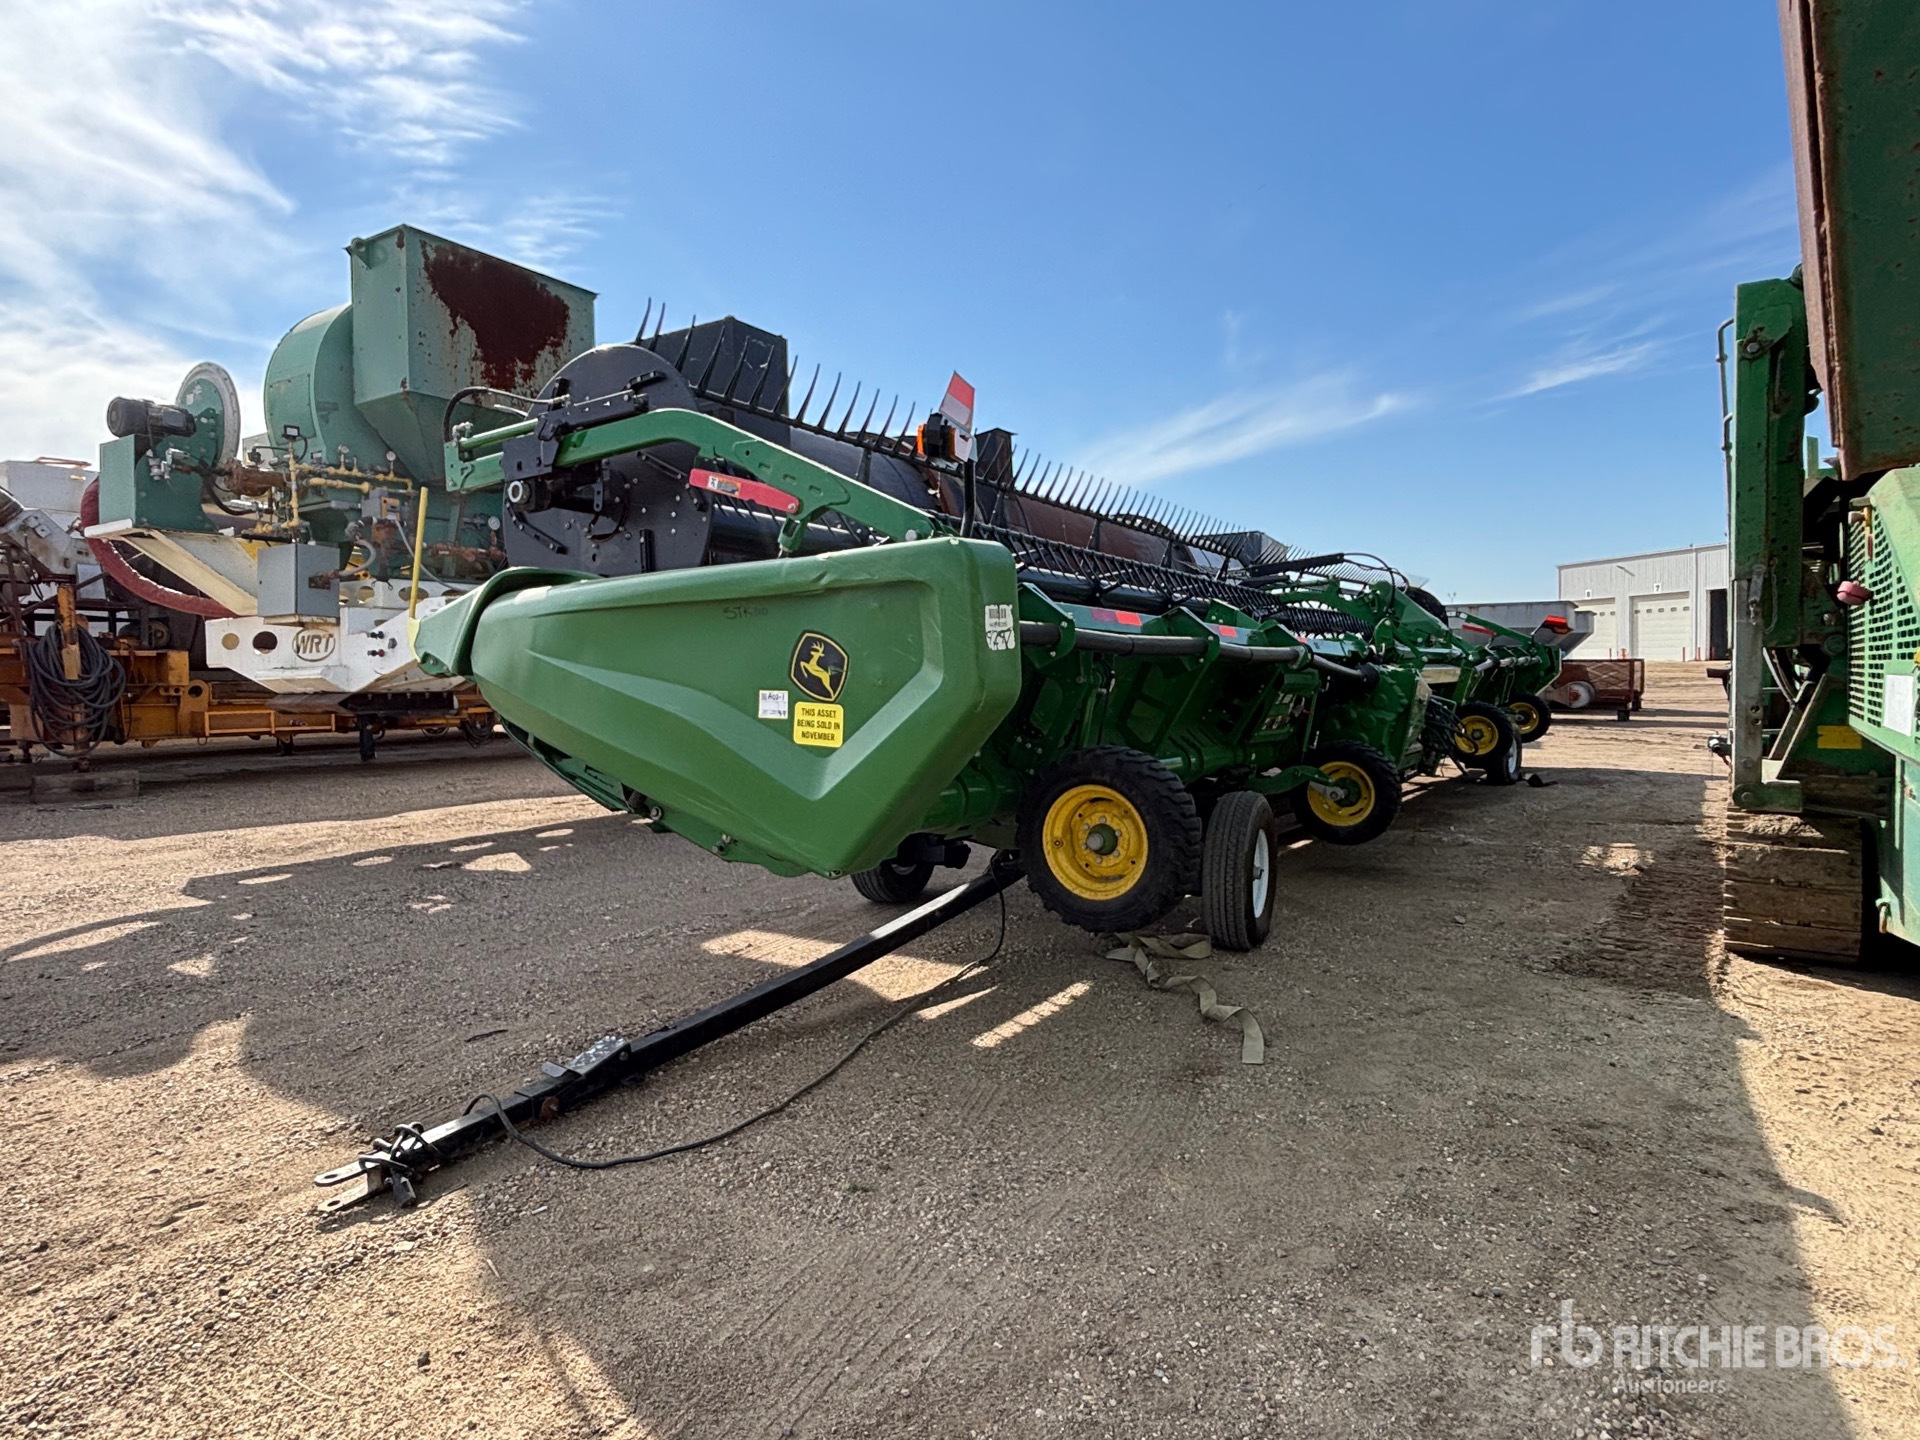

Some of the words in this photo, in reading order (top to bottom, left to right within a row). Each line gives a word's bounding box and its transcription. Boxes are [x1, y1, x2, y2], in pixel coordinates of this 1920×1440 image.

[296, 633, 333, 654] WRT
[801, 708, 815, 717] THIS
[817, 709, 837, 718] ASSET
[797, 719, 815, 728] BEING
[817, 720, 832, 729] SOLD
[834, 721, 840, 730] IN
[801, 731, 835, 741] NOVEMBER
